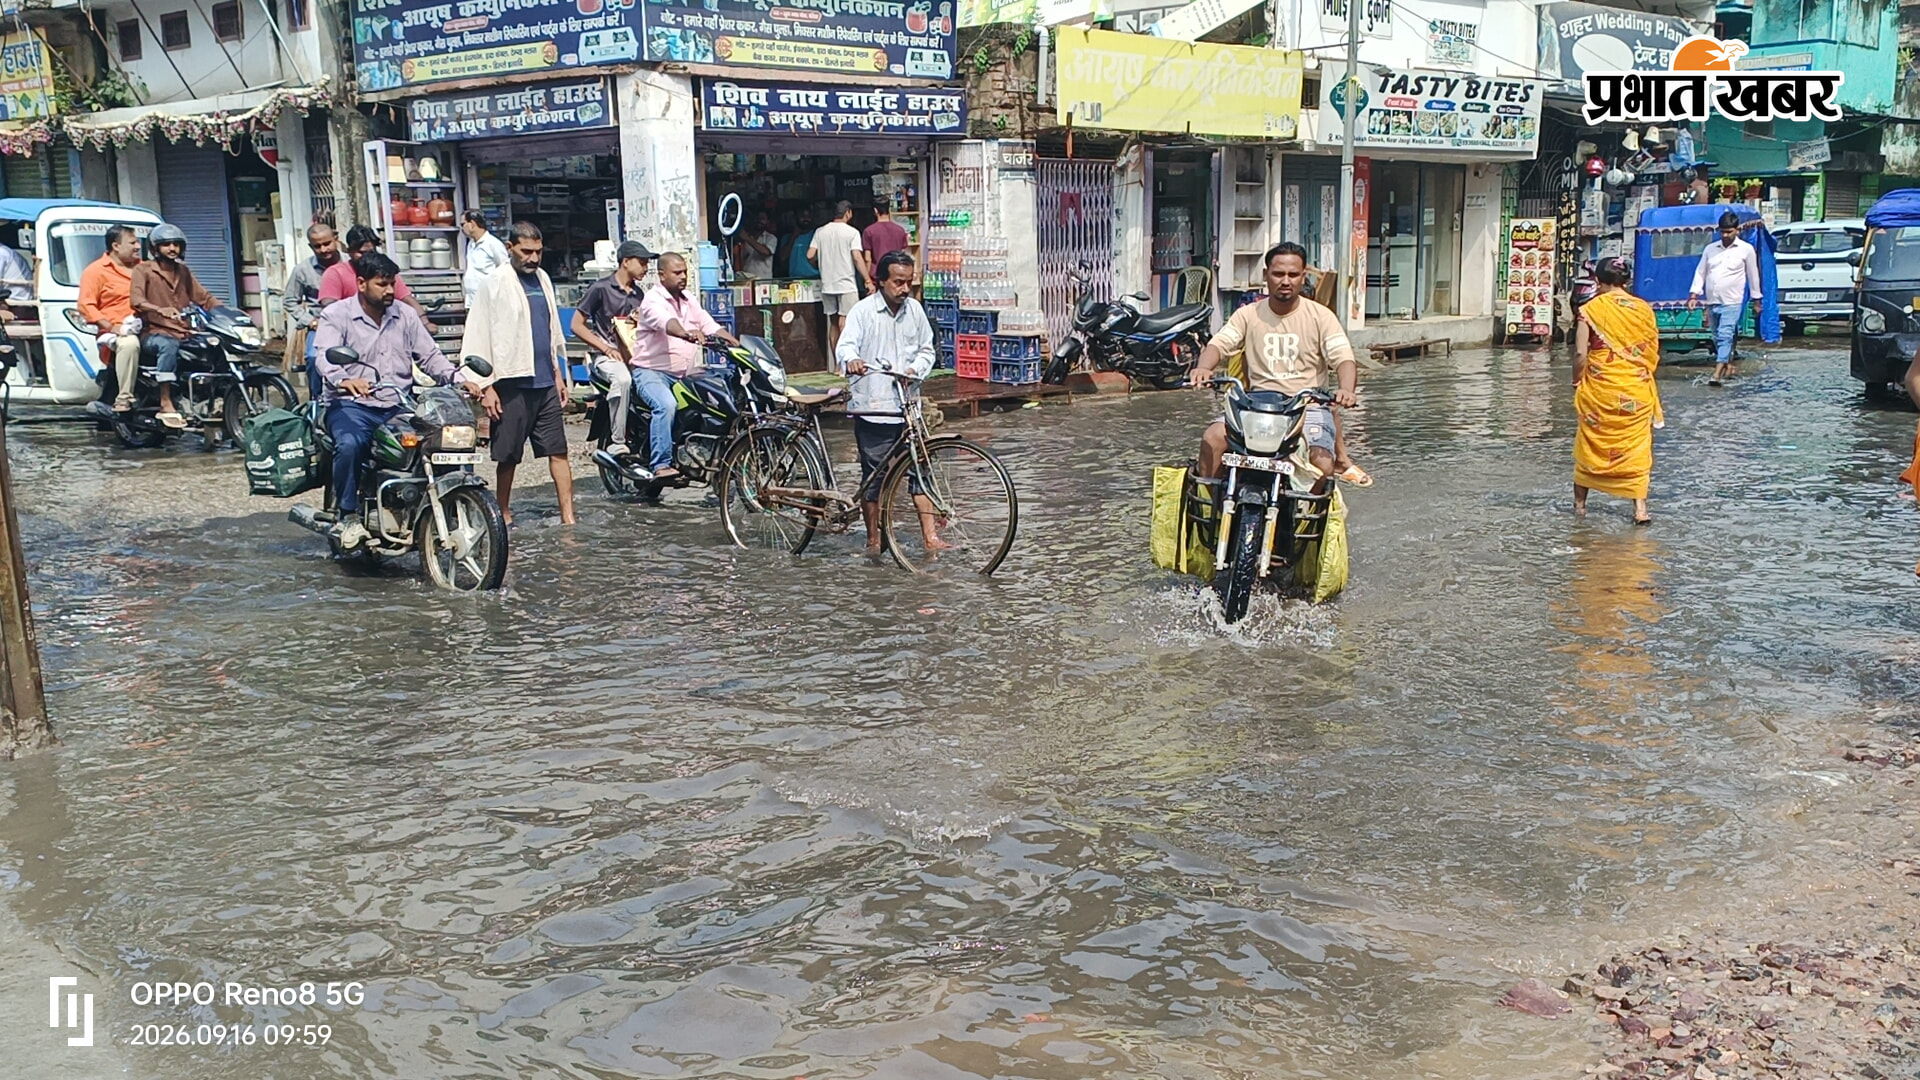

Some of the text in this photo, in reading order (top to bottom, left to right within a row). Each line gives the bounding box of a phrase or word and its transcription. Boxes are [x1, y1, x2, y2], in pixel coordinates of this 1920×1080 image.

[402, 4, 452, 28] आयूष
[1560, 16, 1593, 39] शहर
[1594, 13, 1652, 35] Wedding
[1065, 50, 1145, 101] आयूष
[1378, 72, 1460, 98] TASTY
[1463, 80, 1534, 103] BITES
[412, 99, 448, 120] शिव
[495, 86, 546, 111] लाईट
[551, 83, 602, 105] हाउस
[712, 82, 769, 106] शिव
[836, 88, 899, 111] लाईट
[905, 94, 961, 111] हाउस
[448, 118, 487, 135] आयूष
[769, 111, 824, 129] आयूष
[1002, 148, 1033, 166] चार्जर
